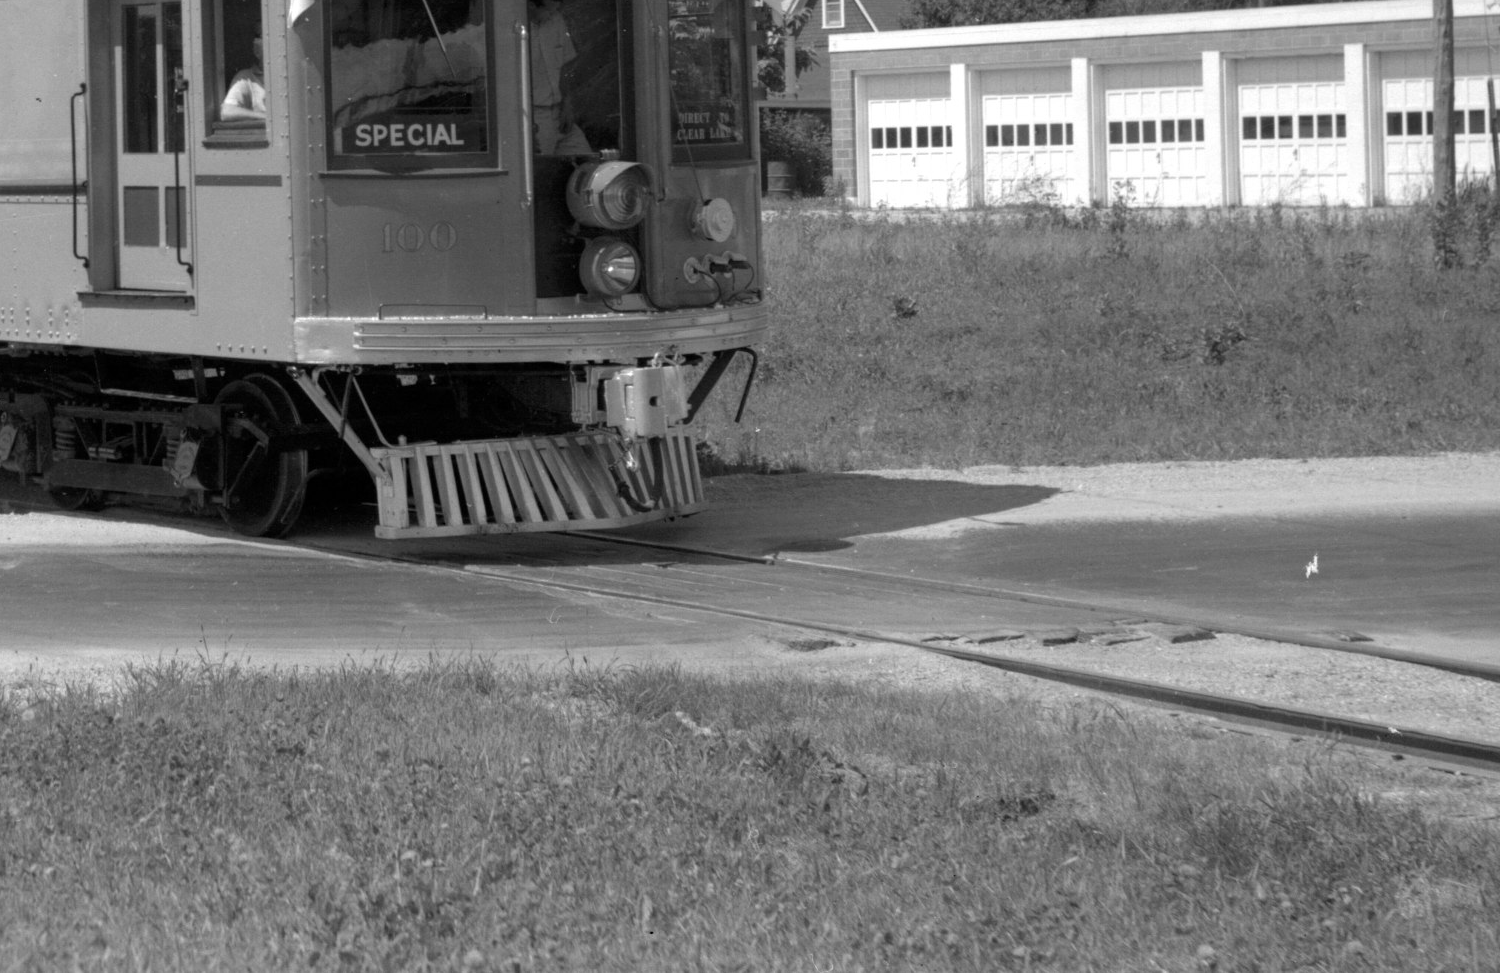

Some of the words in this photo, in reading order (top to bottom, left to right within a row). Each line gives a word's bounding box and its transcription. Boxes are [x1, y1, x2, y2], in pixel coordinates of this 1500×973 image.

[678, 112, 710, 124] DIRECT
[355, 123, 465, 147] SPECIAL
[677, 128, 705, 141] CLEAR
[382, 221, 458, 253] 100
